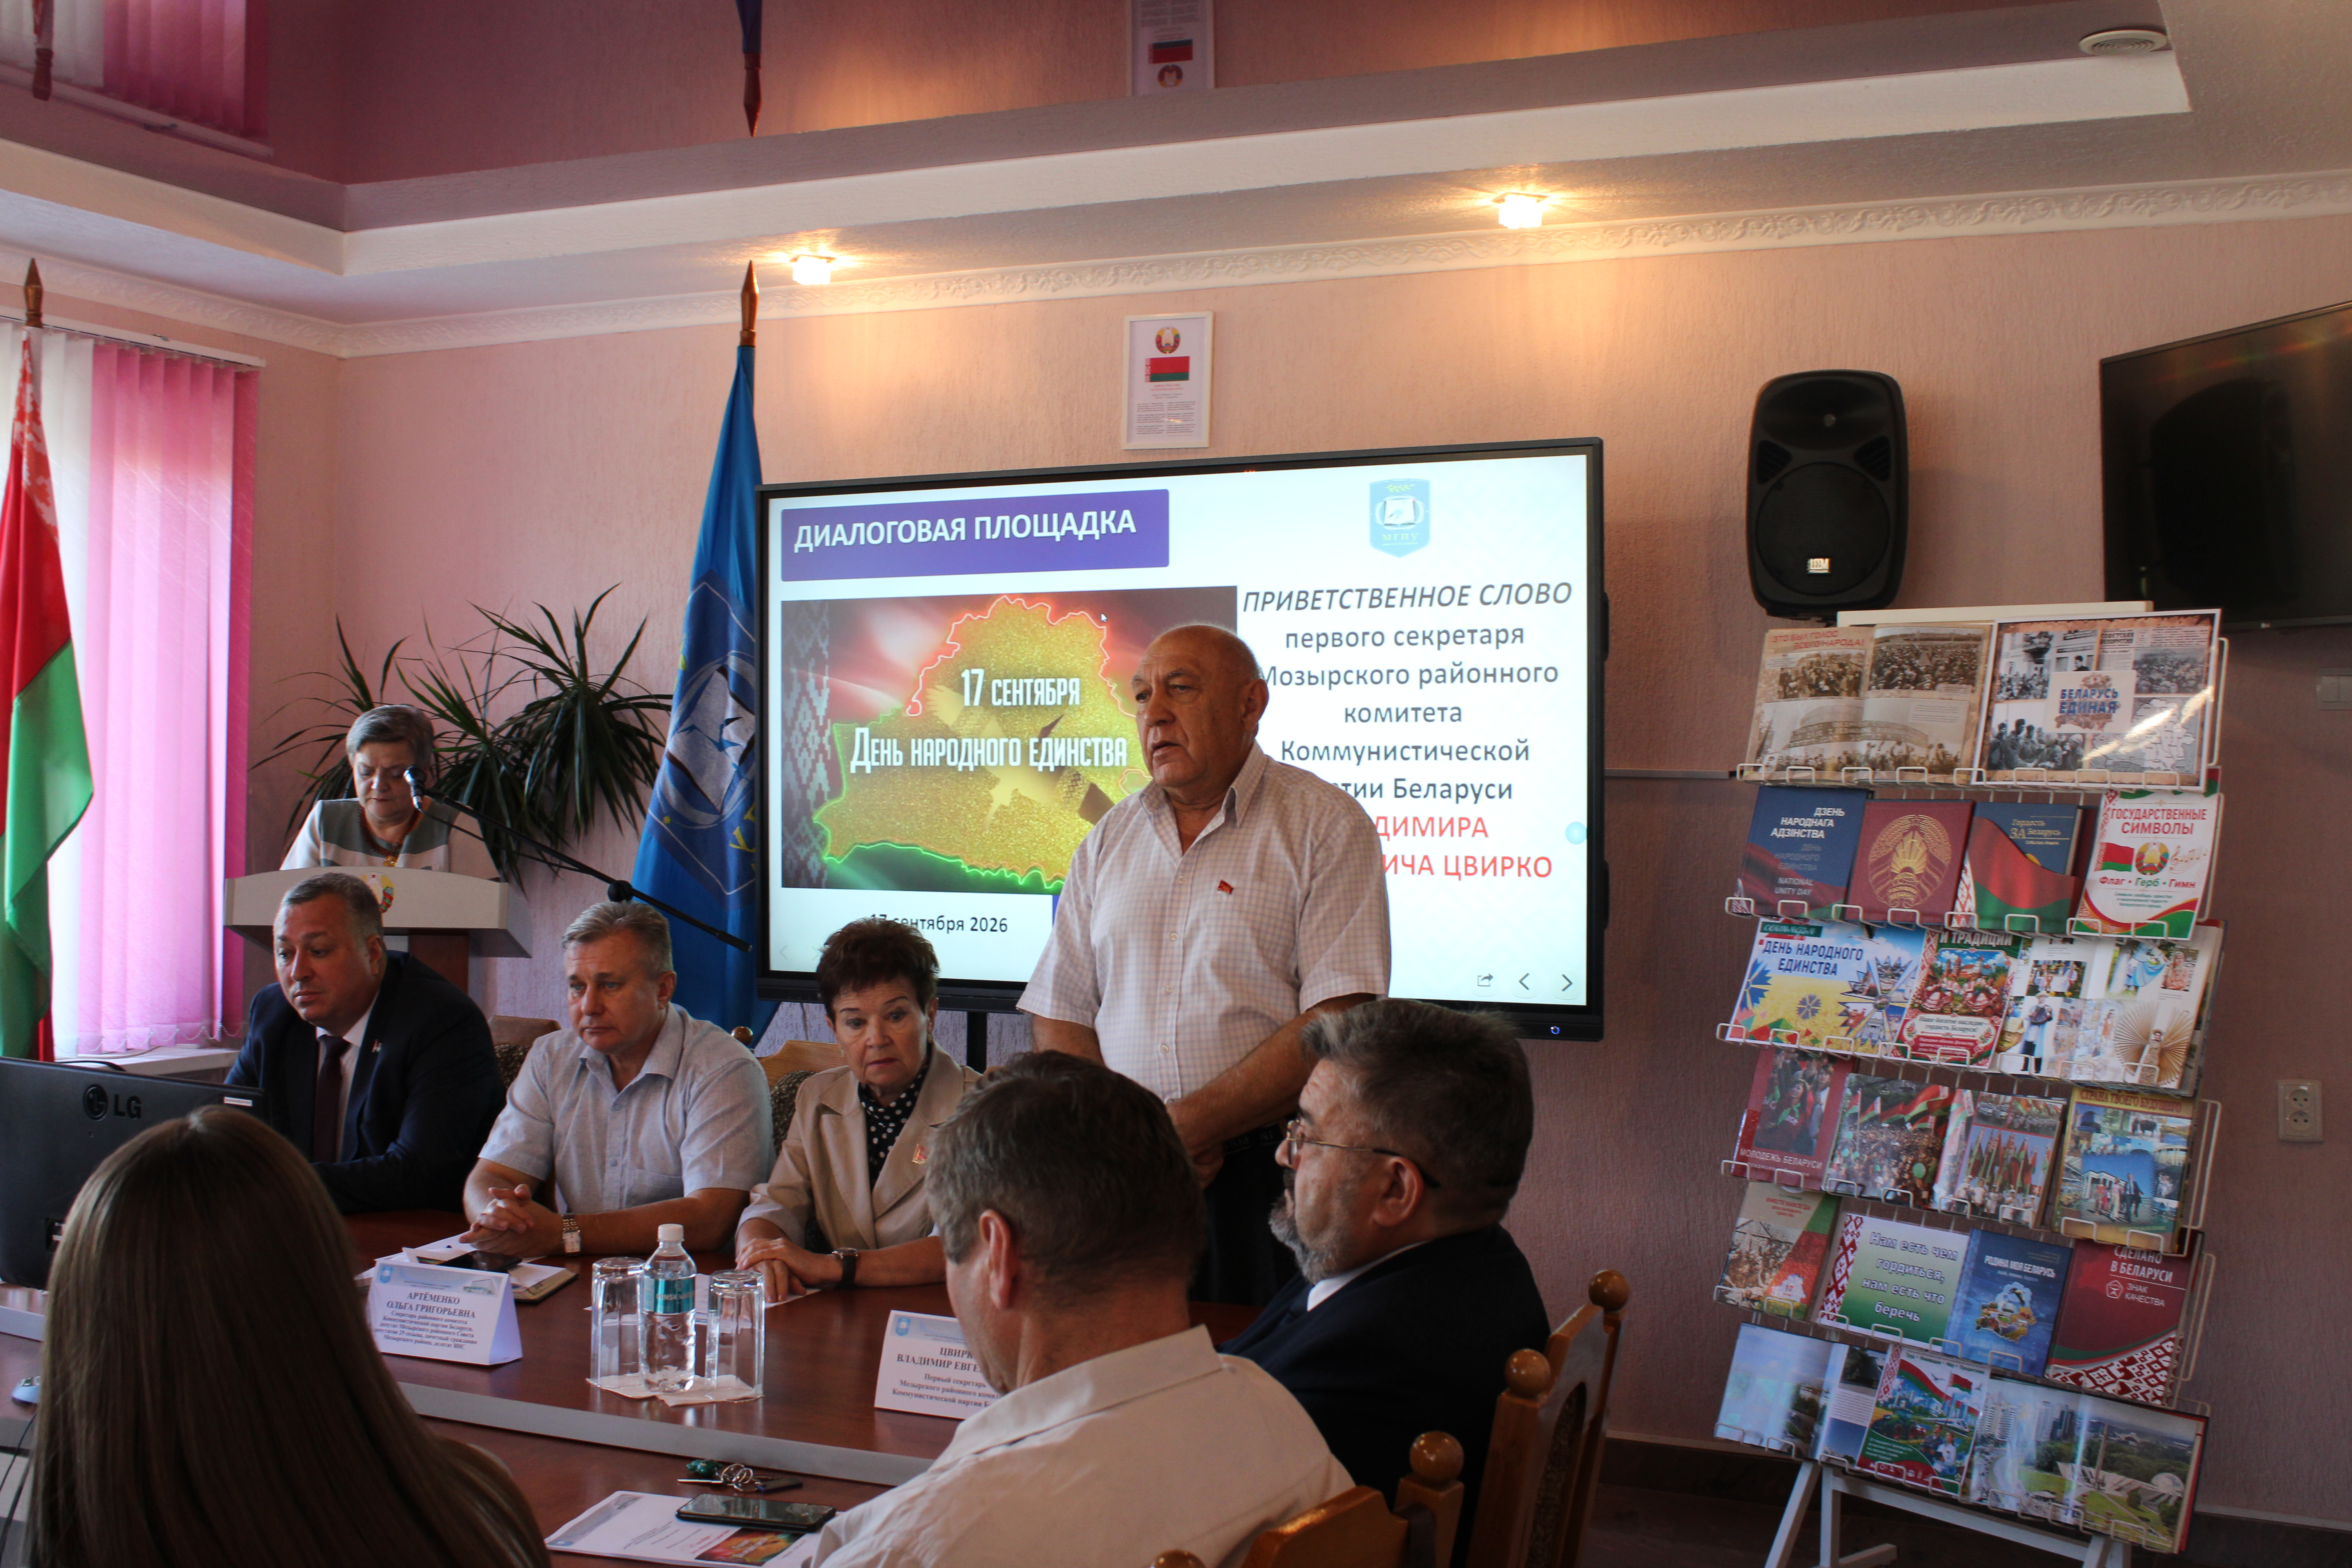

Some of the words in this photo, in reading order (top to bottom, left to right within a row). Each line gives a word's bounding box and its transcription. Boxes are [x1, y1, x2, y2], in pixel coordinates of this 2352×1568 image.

[794, 517, 966, 553] ДИАЛОГОВАЯ
[974, 509, 1136, 541] ПЛОЩАДКА
[1382, 533, 1418, 542] МГПУ
[1243, 585, 1471, 612] ПРИВЕТСТВЕННОЕ
[1479, 581, 1572, 606] СЛОВО
[1286, 630, 1385, 653] первого
[1394, 628, 1524, 651] секретаря
[1811, 631, 1838, 639] ГОЛОС
[1419, 661, 1558, 689] районного
[962, 668, 984, 707] 17
[2060, 688, 2119, 699] БЕЛАРУСЬ
[1345, 706, 1462, 723] комитета
[2058, 701, 2116, 715] ЕДИНАЯ
[1281, 738, 1530, 767] Коммунистической
[1394, 778, 1513, 805] Беларуси
[1813, 807, 1845, 817] ДЗЕНЬ
[2111, 808, 2207, 821] ГОСУДАРСТВЕННЫЕ
[1375, 815, 1489, 842] ДИМИРА
[1780, 817, 1835, 828] НАРОДНАГА
[2122, 822, 2194, 835] СИМВОЛЫ
[1770, 828, 1825, 838] АДЗІНСТВА
[2010, 828, 2026, 839] ЗА
[1444, 855, 1552, 881] ЦВИРКО
[1778, 877, 1814, 886] NATIONAL
[2099, 876, 2125, 886] Флаг
[2135, 877, 2160, 888] Герб
[2168, 879, 2196, 888] Гимн
[970, 917, 1007, 932] 2026
[1952, 931, 2014, 947] ТРАДИЦИИ
[1762, 941, 1792, 954] ДЕНЬ
[1796, 943, 1863, 960] НАРОДНОГО
[1778, 958, 1838, 976] ЕДИНСТВА
[114, 1094, 142, 1119] LG
[1740, 1148, 1781, 1162] МОЛОДЕЖЬ
[1783, 1156, 1823, 1169] БЕЛАРУСИ
[1870, 1232, 1897, 1249] Нам
[1900, 1241, 1928, 1255] есть
[1933, 1247, 1958, 1261] чем
[2114, 1246, 2162, 1264] СДЕЛАНО
[1876, 1258, 1945, 1284] гордиться,
[2023, 1263, 2056, 1278] БЕЛАРУСЬ
[2110, 1261, 2118, 1272] В
[2120, 1262, 2173, 1283] БЕЛАРУСИ
[1862, 1278, 1888, 1292] нам
[1891, 1285, 1920, 1299] есть
[1924, 1291, 1945, 1304] что
[2127, 1283, 2149, 1293] ЗНАК
[2125, 1292, 2165, 1307] КАЧЕСТВА
[387, 1301, 413, 1311] ОЛЬГА
[415, 1304, 476, 1318] ГРИГОРЬЕВНА
[1875, 1301, 1920, 1321] беречь
[897, 1354, 952, 1368] ВЛАДИМИР
[940, 1347, 973, 1359] ЦВИРК
[900, 1379, 940, 1392] Мозырского
[942, 1387, 977, 1397] районного
[924, 1373, 951, 1383] Первый
[953, 1379, 987, 1388] секретарь
[892, 1388, 956, 1403] Коммунистической
[958, 1399, 982, 1407] партии
